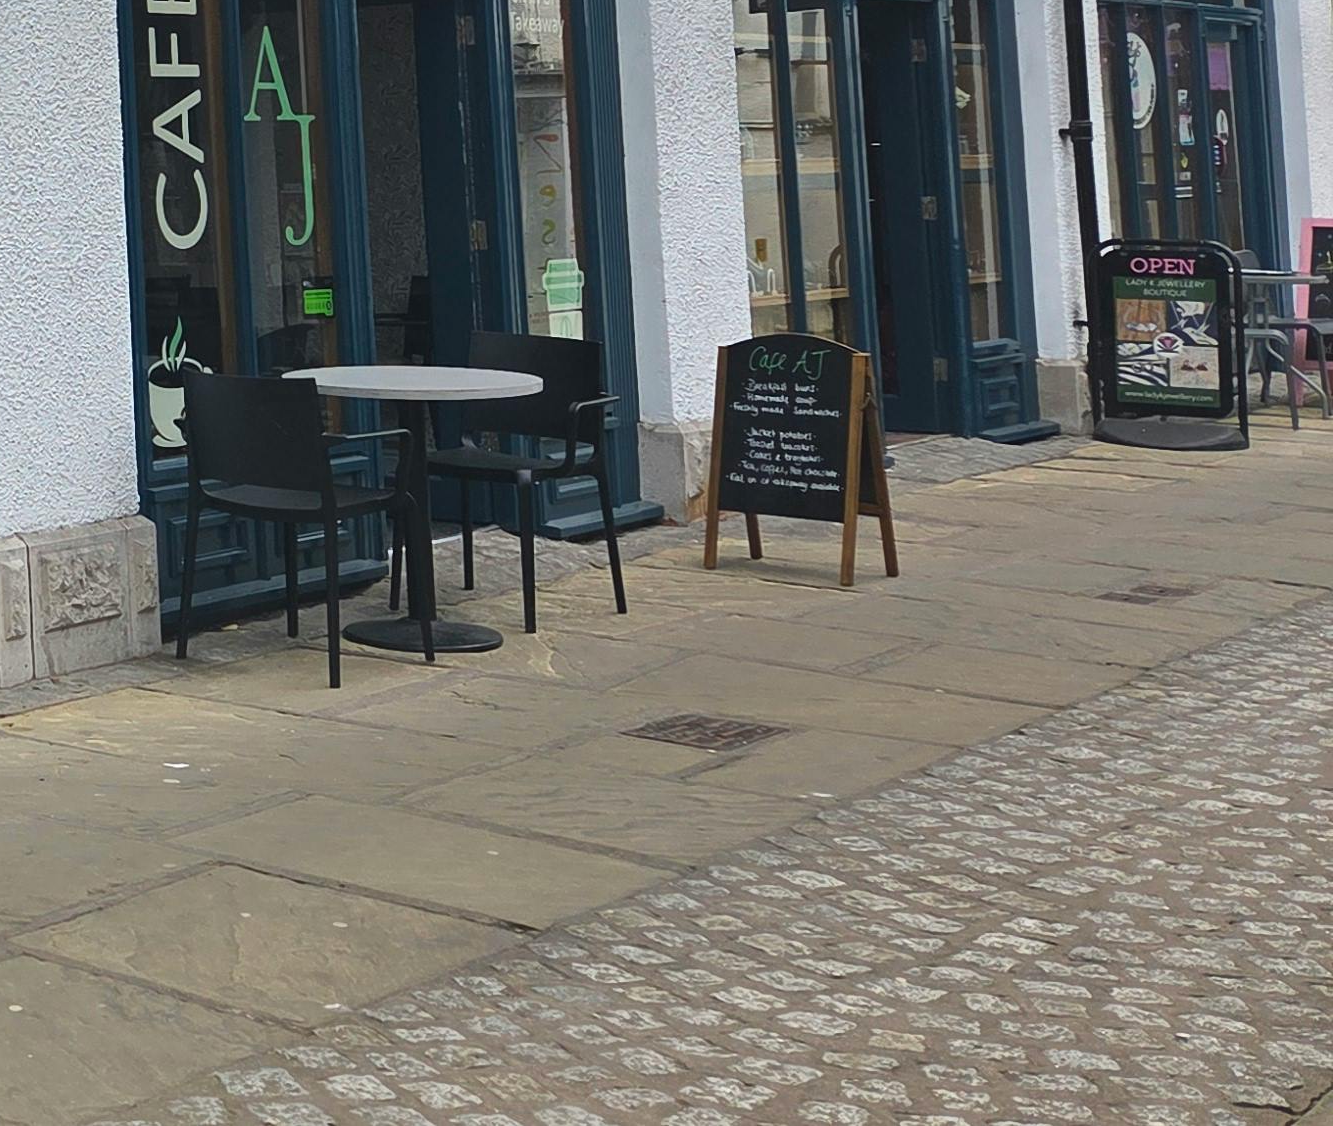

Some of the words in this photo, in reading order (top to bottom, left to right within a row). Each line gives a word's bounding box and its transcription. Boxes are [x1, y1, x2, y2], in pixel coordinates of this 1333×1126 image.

[1129, 256, 1197, 275] OPEN
[1125, 278, 1148, 287] LADY
[1156, 279, 1206, 289] JEWELLERY
[1143, 288, 1188, 297] BOUTIQUE
[749, 345, 787, 375] Cafe
[791, 349, 832, 381] AJ
